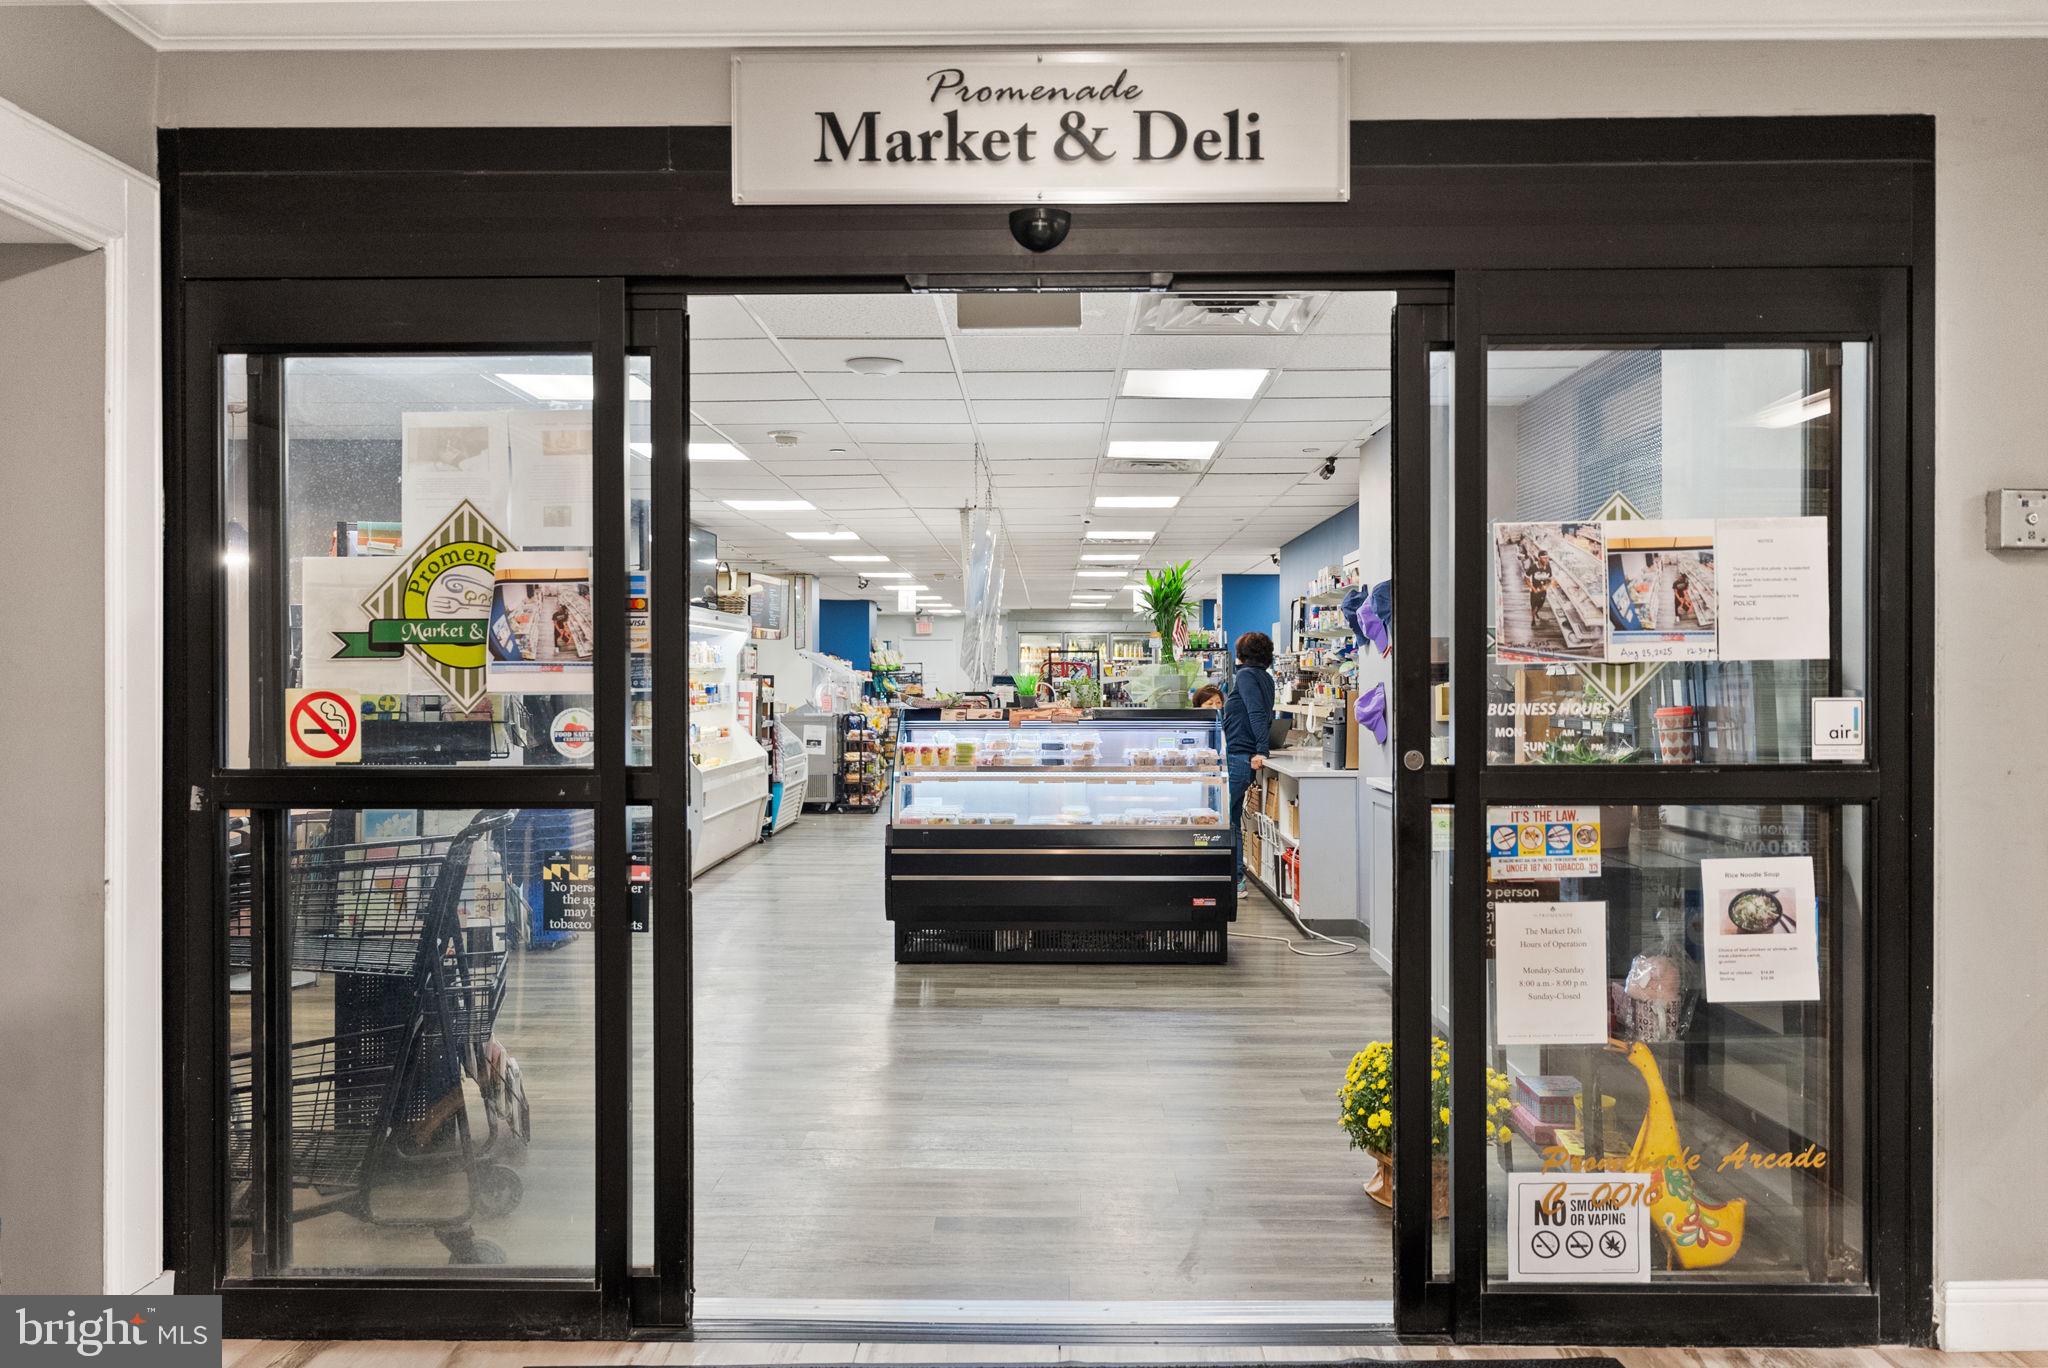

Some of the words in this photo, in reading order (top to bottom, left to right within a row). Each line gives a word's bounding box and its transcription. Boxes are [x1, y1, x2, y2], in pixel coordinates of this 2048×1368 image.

[927, 68, 1143, 103] Promenade
[814, 109, 1037, 163] Market
[1053, 110, 1116, 162] &
[1132, 109, 1264, 162] Deli
[401, 622, 464, 642] Market
[469, 623, 485, 640] &
[1487, 702, 1556, 716] BUSINESS
[1558, 702, 1611, 716] HOURS
[1511, 811, 1529, 822] IT'S
[1533, 811, 1552, 822] THE
[1506, 864, 1528, 873] UNDER
[1543, 863, 1552, 872] NO
[1554, 862, 1584, 871] TOBACCO
[550, 882, 567, 892] No
[562, 894, 580, 904] the
[1495, 888, 1539, 899] person
[564, 908, 587, 919] may
[549, 919, 592, 929] tobacco
[1525, 927, 1538, 935] The
[1540, 927, 1565, 935] Market
[1567, 927, 1582, 935] Deli
[1552, 941, 1587, 949] Operation
[1717, 1142, 1827, 1173] Arcade
[1534, 1199, 1566, 1226] NO
[1570, 1199, 1620, 1213] SMOKING
[1570, 1213, 1585, 1226] OR
[1587, 1212, 1626, 1226] VAPING
